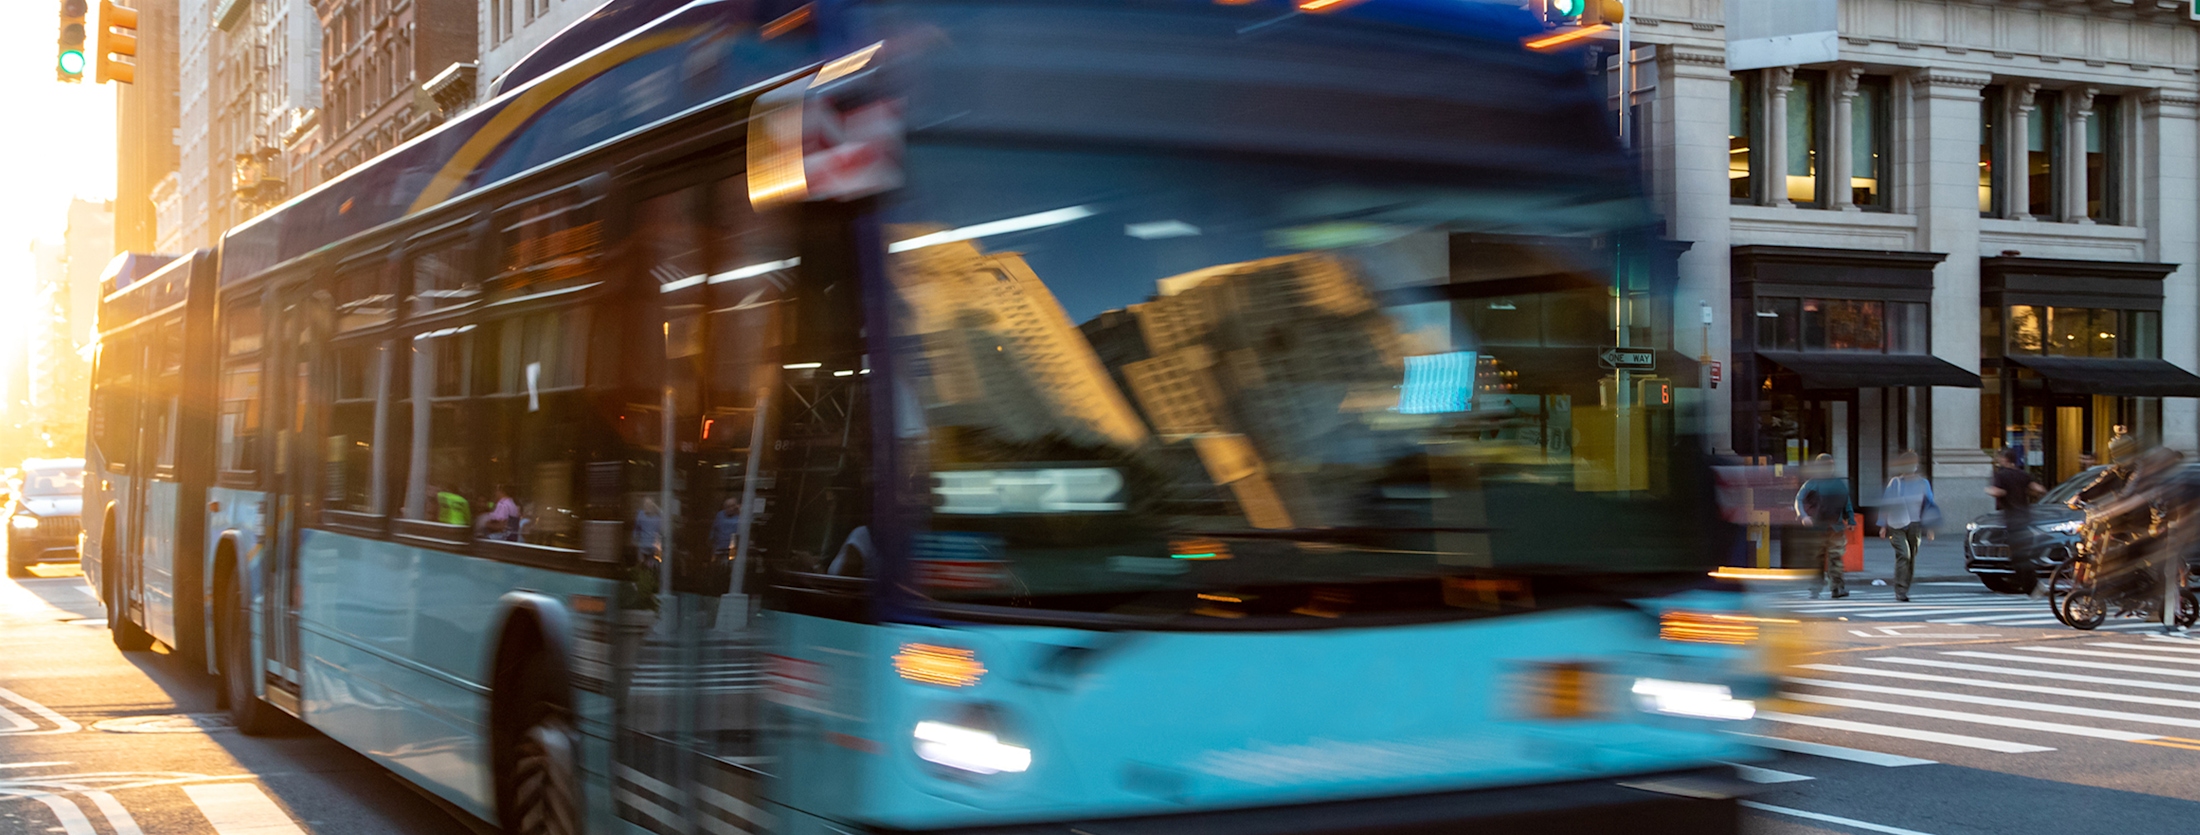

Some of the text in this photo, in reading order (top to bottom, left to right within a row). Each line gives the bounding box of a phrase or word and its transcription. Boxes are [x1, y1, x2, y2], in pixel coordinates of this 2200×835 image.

[1608, 354, 1650, 363] ONE WAY
[1661, 384, 1669, 403] 6
